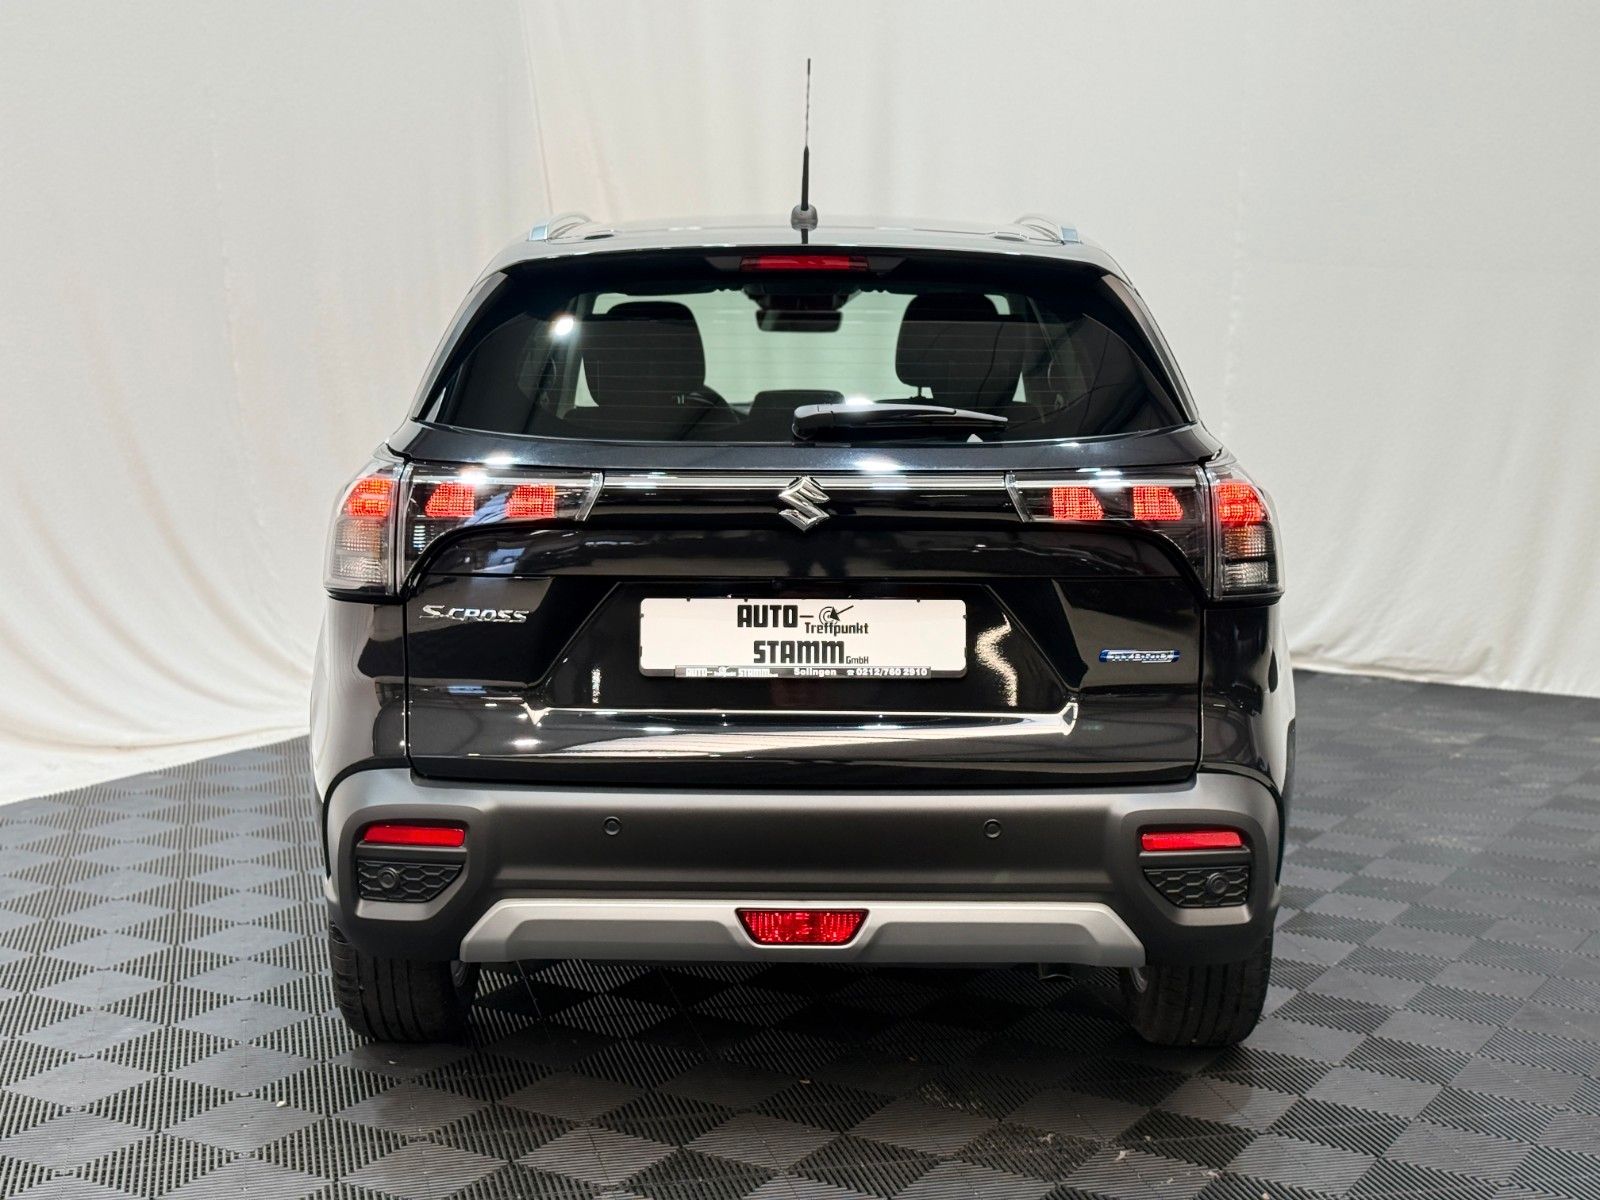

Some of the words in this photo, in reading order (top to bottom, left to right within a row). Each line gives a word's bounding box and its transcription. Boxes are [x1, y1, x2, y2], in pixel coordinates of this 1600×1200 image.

[804, 622, 869, 637] Treffpunkt
[753, 640, 845, 664] STAMM
[846, 655, 869, 665] GmbH
[794, 667, 837, 678] Solingen
